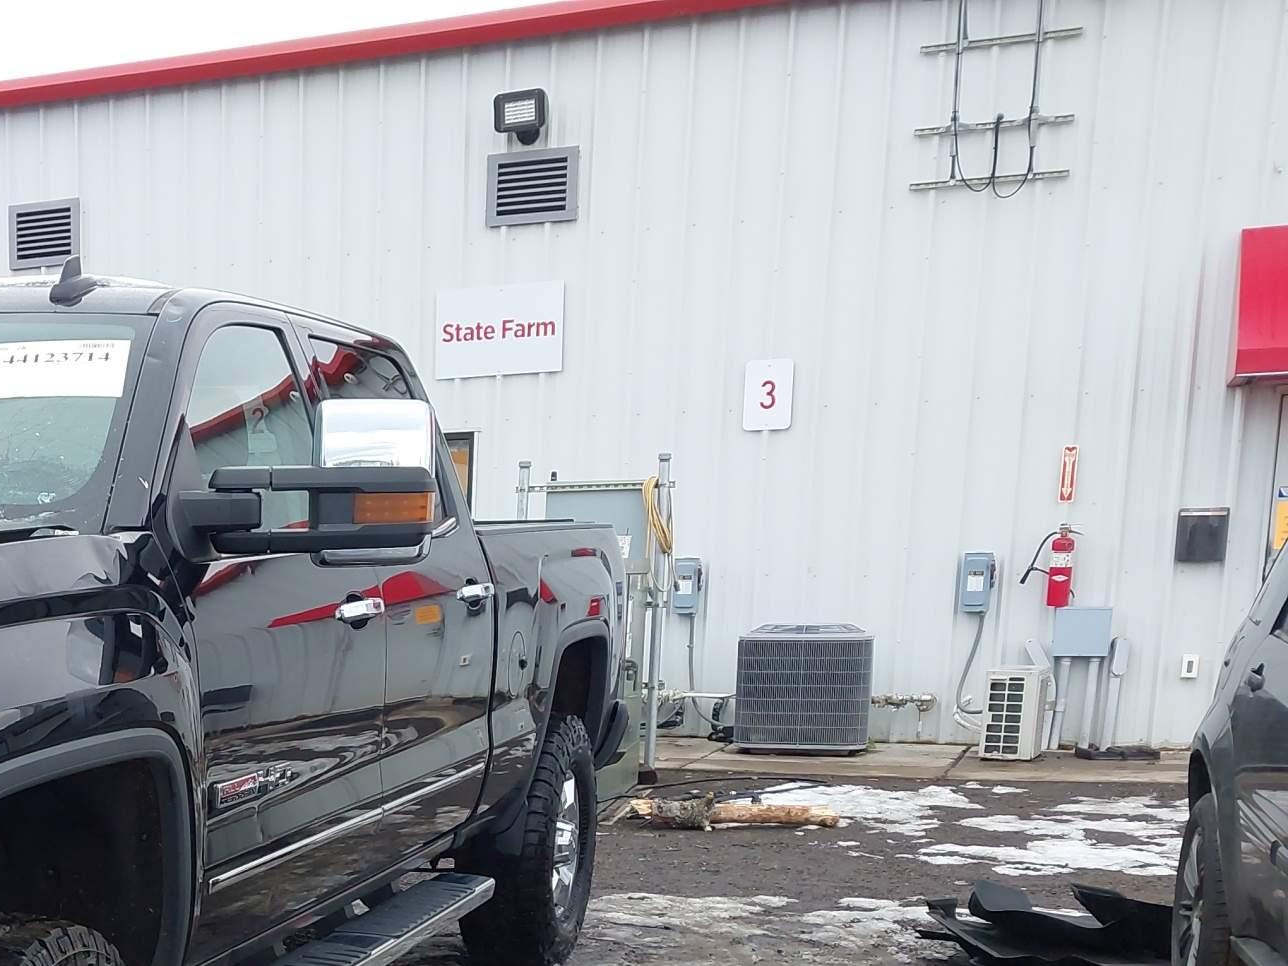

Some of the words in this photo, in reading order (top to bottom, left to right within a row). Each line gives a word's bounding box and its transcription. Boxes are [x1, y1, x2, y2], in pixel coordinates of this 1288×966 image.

[442, 323, 496, 343] State
[501, 318, 556, 339] Farm
[2, 351, 111, 364] 44123714
[759, 380, 776, 410] 3
